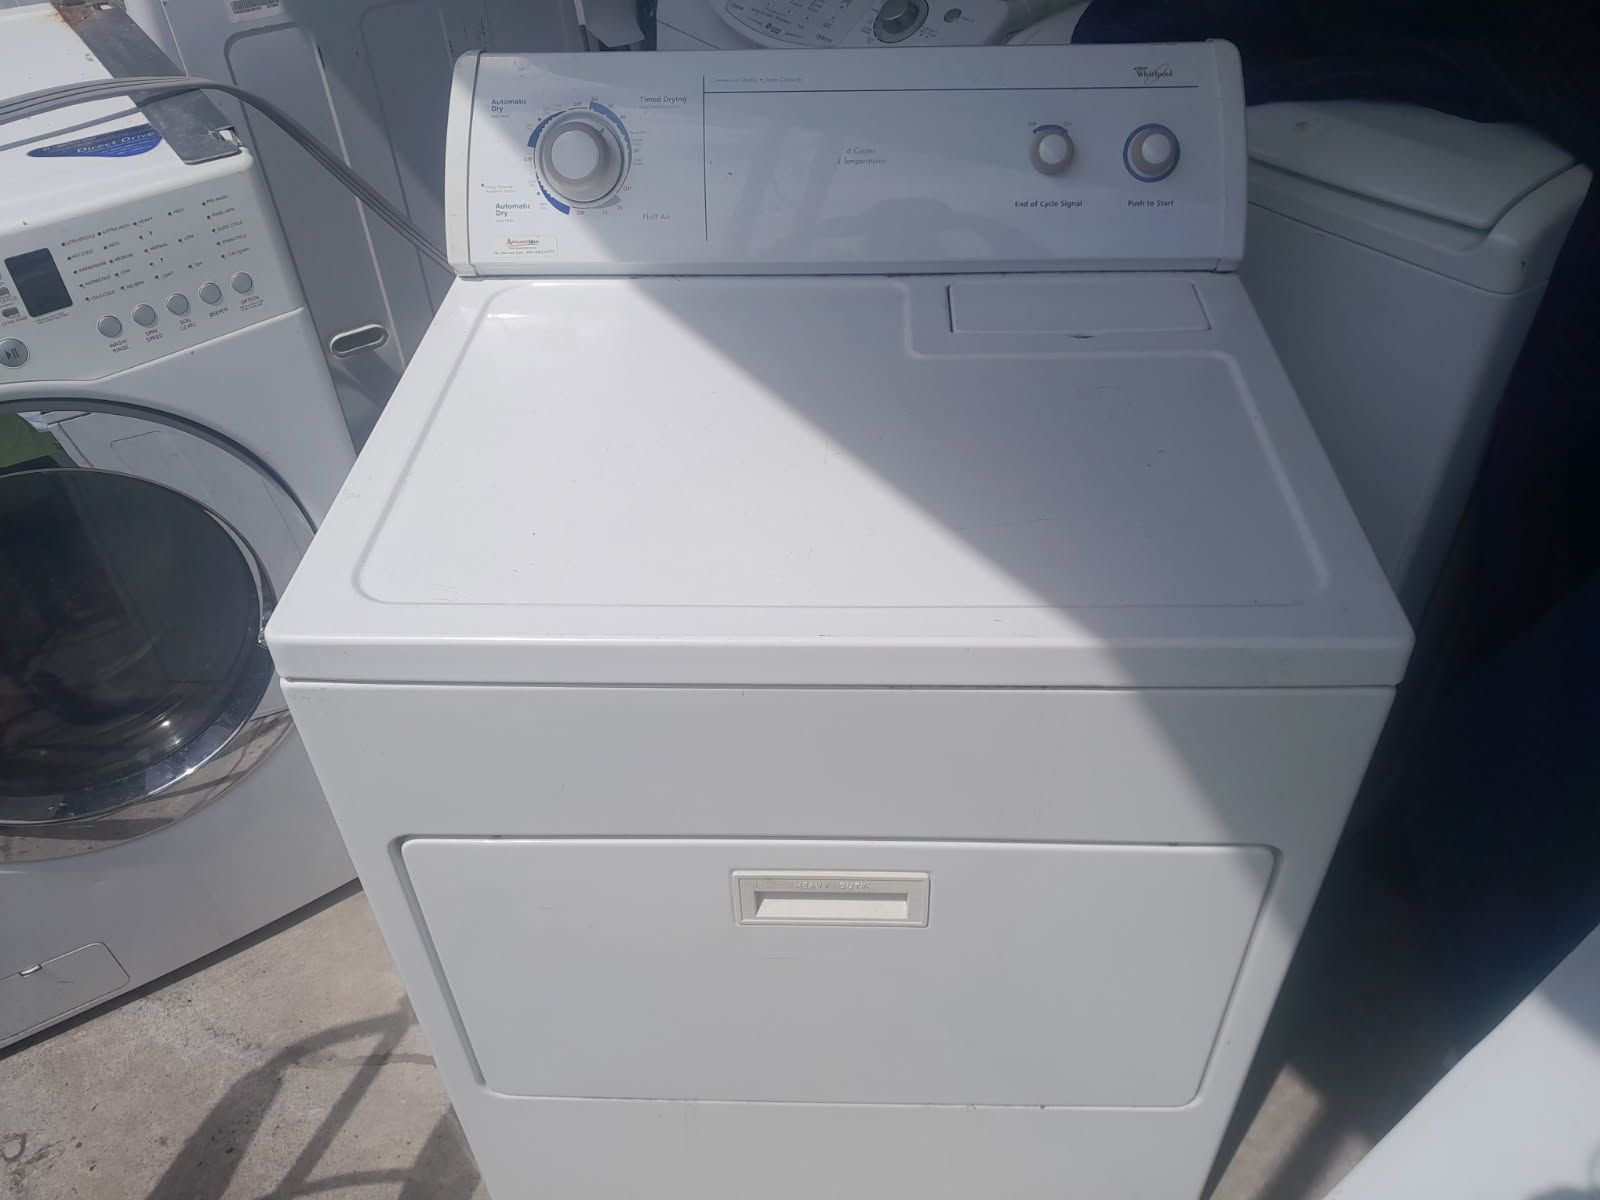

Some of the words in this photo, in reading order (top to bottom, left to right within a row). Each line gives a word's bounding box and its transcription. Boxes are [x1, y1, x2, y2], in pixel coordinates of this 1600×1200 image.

[1136, 69, 1173, 79] Whirlpool
[663, 96, 687, 105] Drying
[491, 105, 504, 113] Dry
[76, 140, 117, 153] Direct
[121, 131, 154, 143] Drive
[495, 202, 531, 210] Automatic
[1015, 200, 1028, 208] End
[1030, 199, 1038, 208] of
[1040, 199, 1059, 209] Cycle
[1060, 199, 1083, 209] Signal
[1128, 199, 1145, 208] Push
[1146, 200, 1155, 208] to
[1156, 199, 1174, 208] Start
[495, 209, 508, 217] Dry
[642, 213, 659, 221] Fluff
[660, 213, 671, 221] Air
[793, 880, 831, 890] HEAVY
